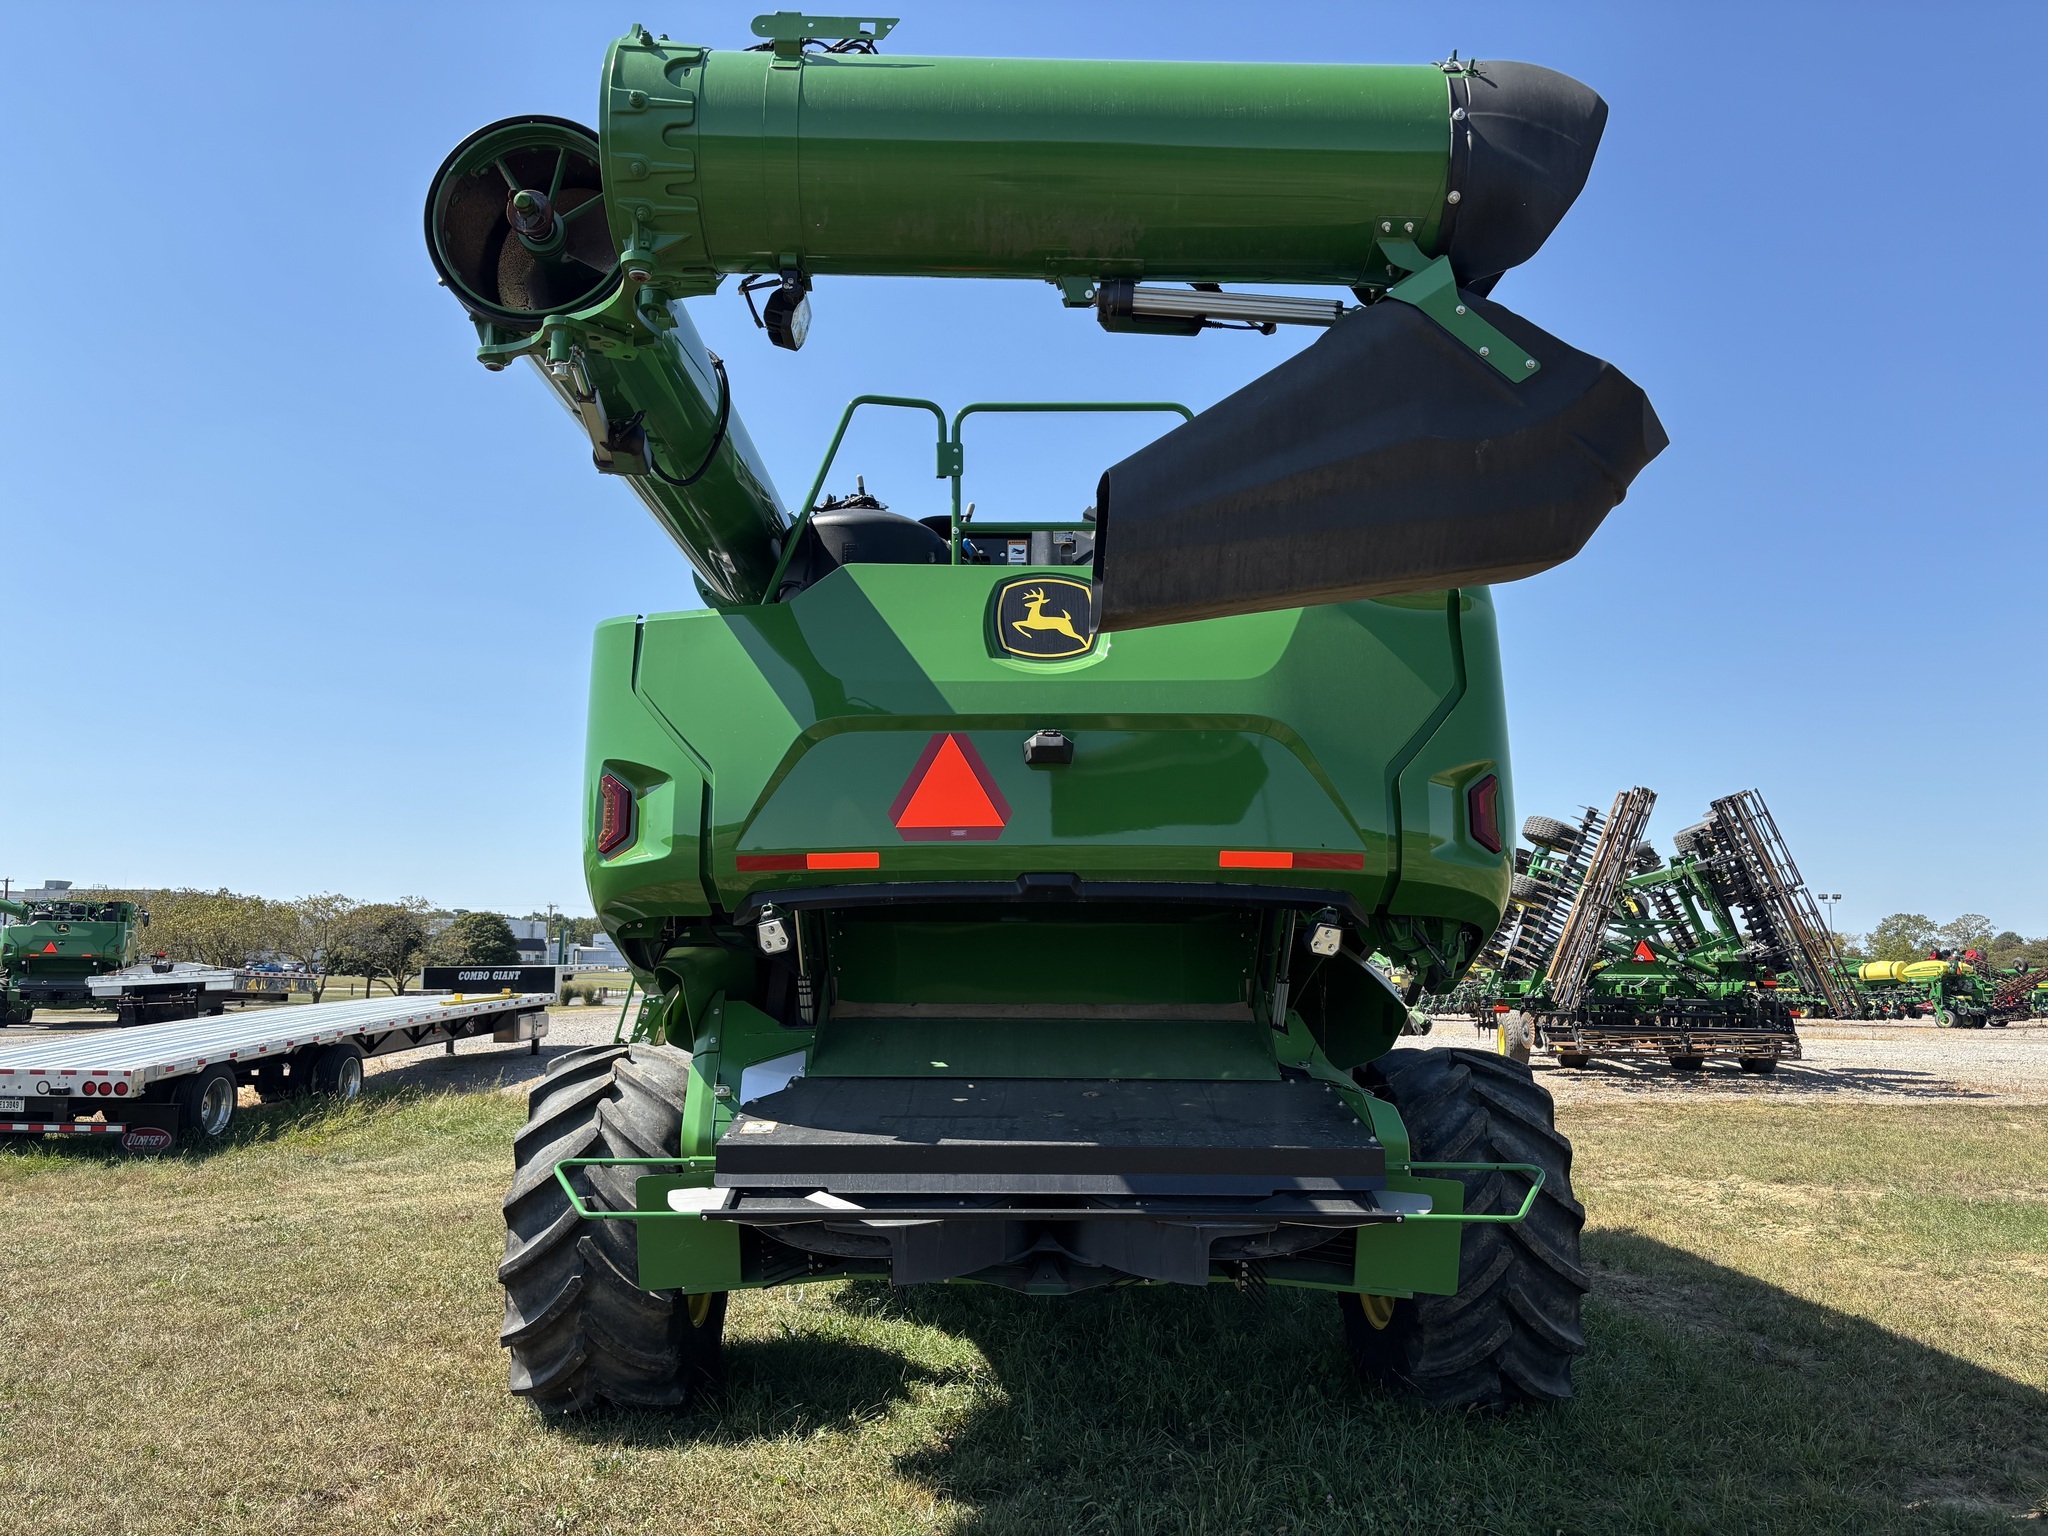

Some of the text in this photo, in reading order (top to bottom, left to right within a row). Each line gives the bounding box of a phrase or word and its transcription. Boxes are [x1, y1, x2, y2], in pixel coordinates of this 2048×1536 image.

[458, 971, 521, 980] COMBO GIANT
[126, 1133, 167, 1146] DORSEY
